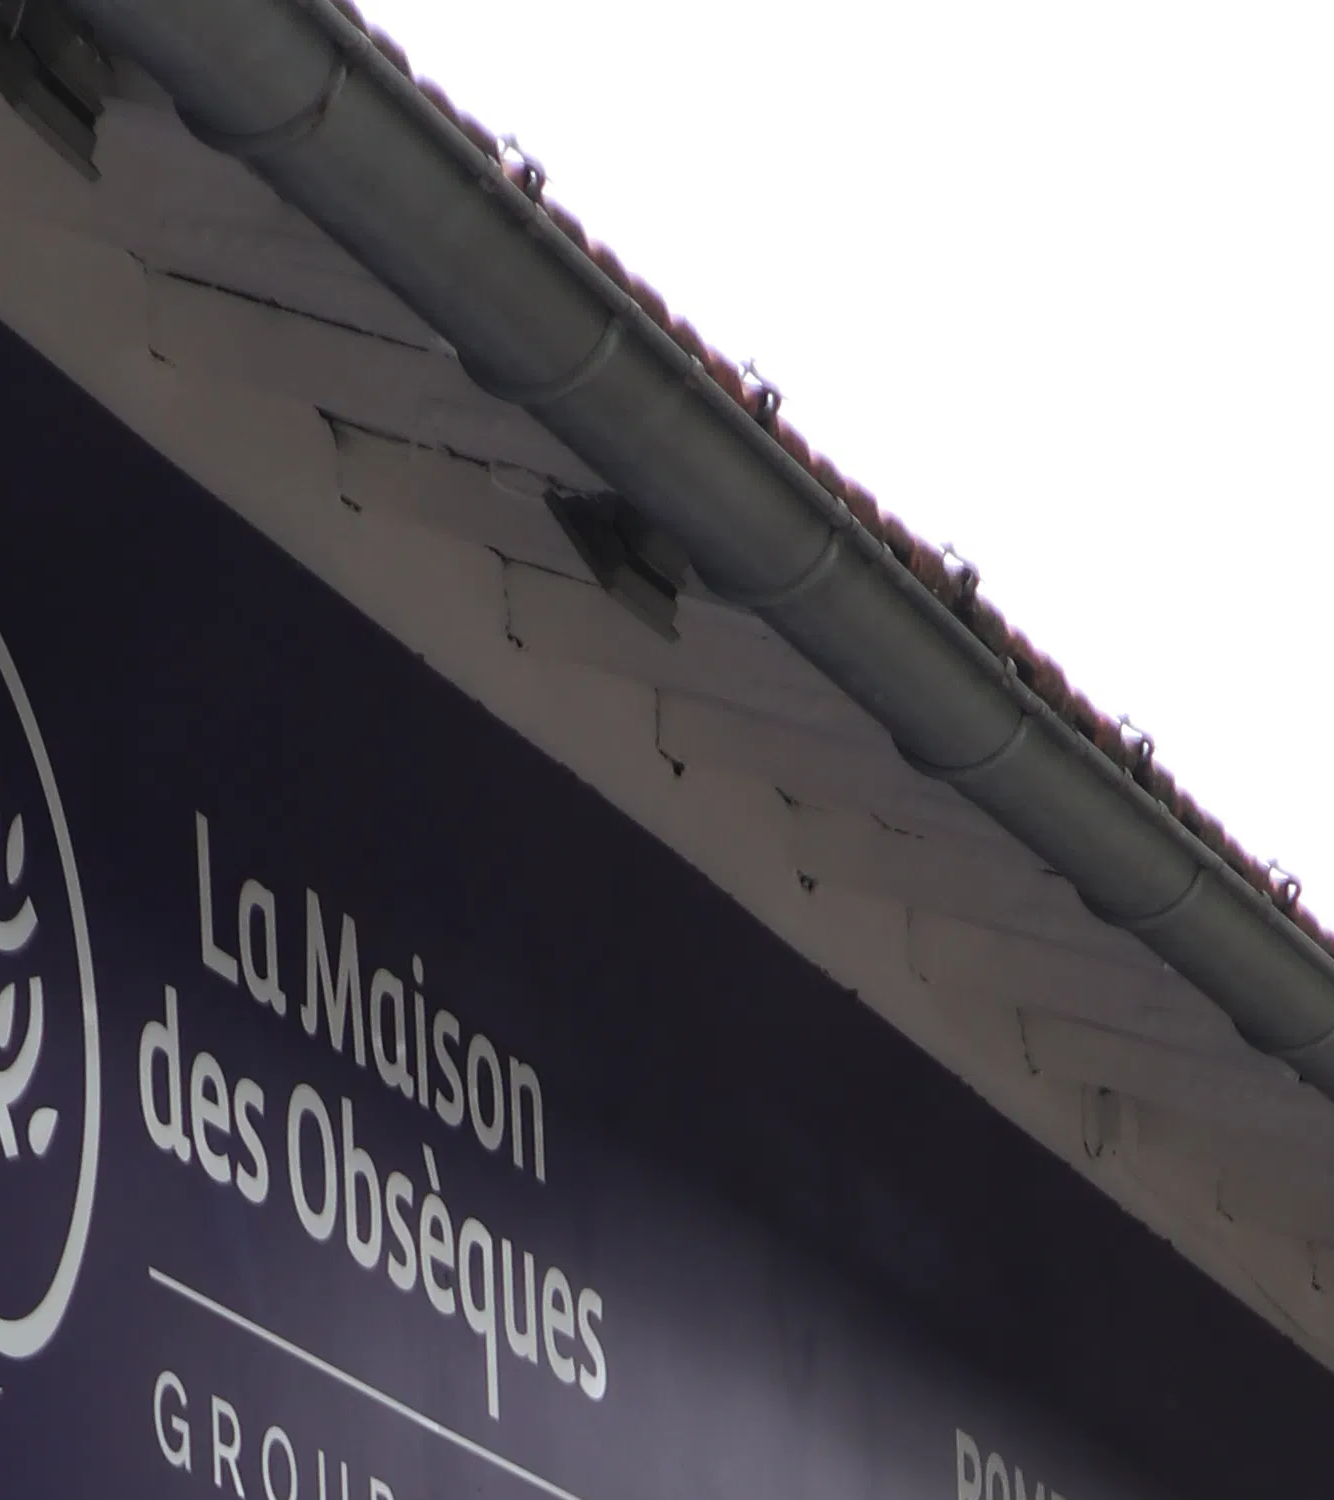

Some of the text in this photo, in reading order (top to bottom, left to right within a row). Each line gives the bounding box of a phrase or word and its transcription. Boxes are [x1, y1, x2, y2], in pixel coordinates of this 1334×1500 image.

[195, 811, 546, 1184] La Maison
[138, 984, 607, 1421] des Obsèques
